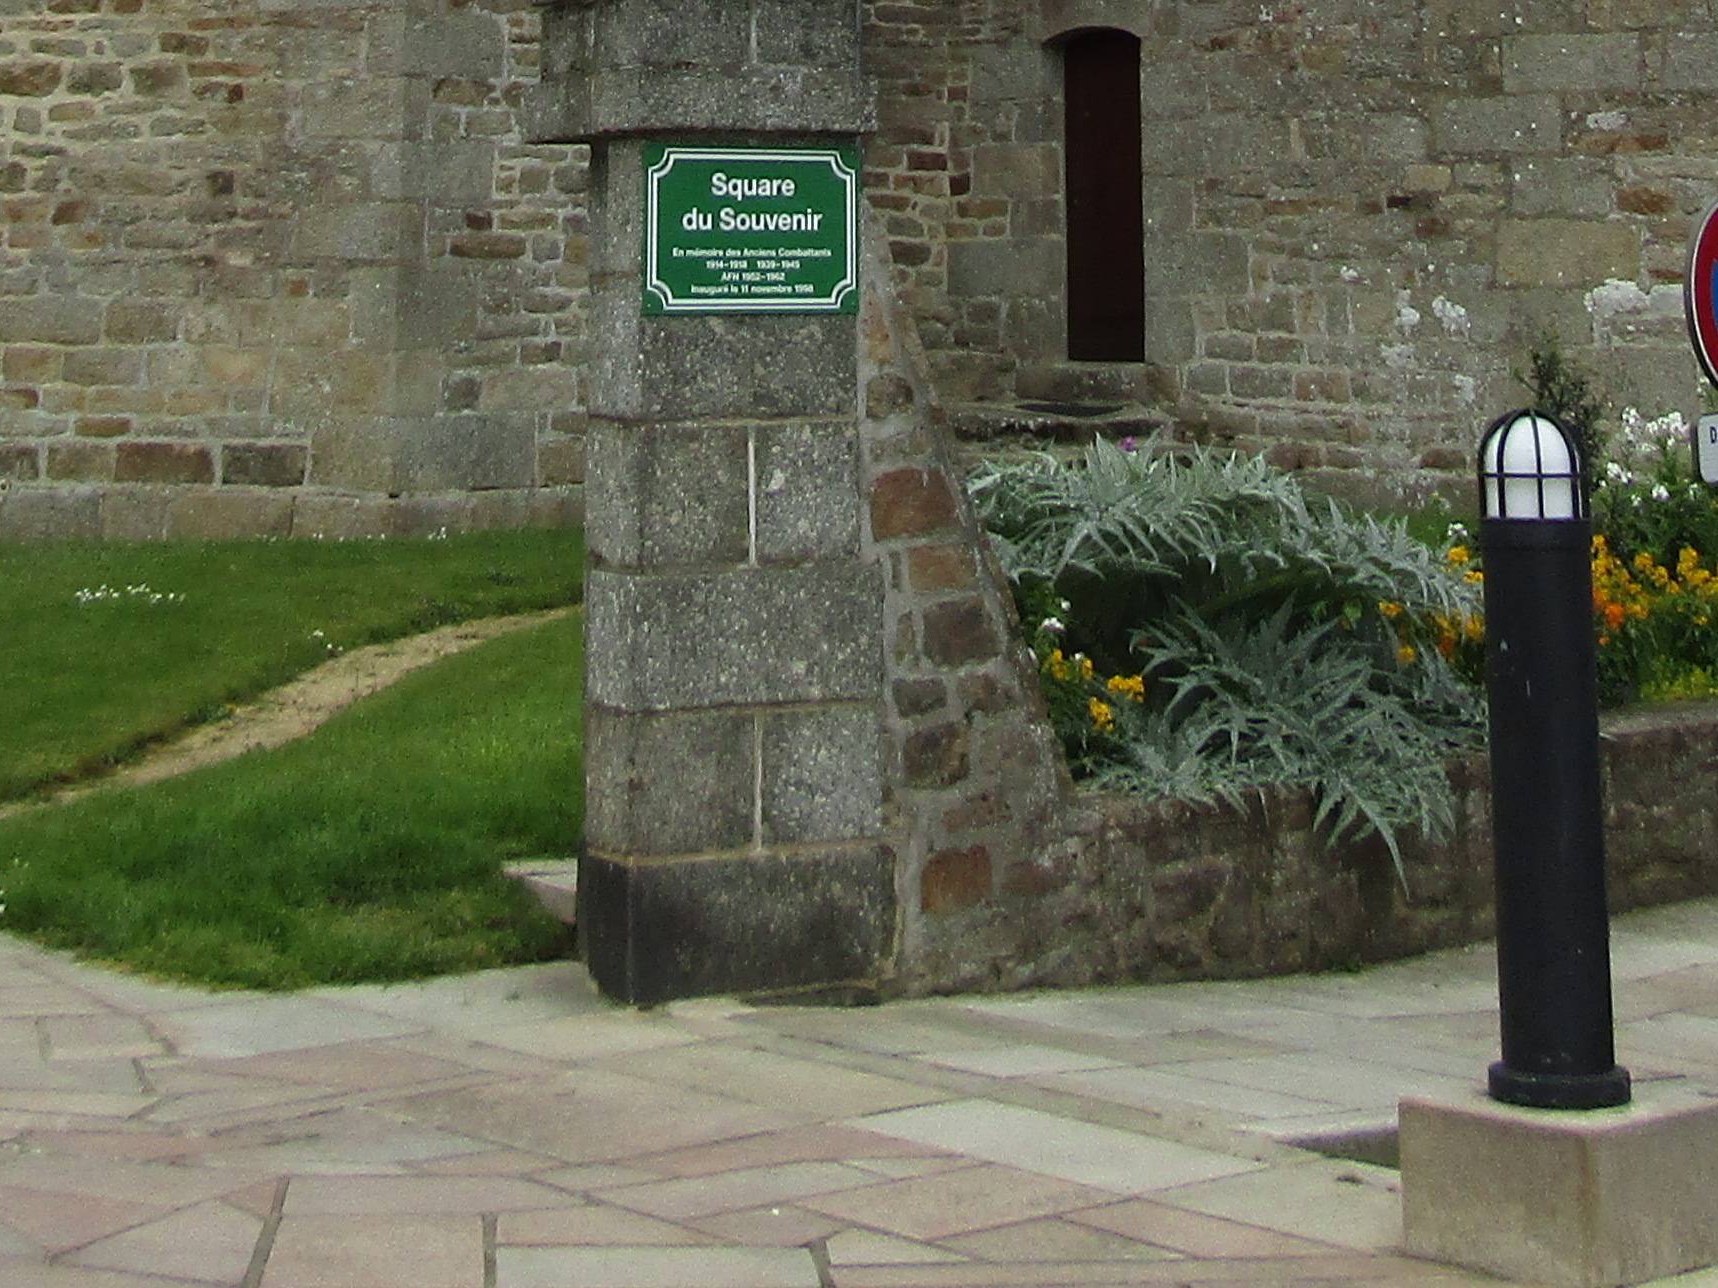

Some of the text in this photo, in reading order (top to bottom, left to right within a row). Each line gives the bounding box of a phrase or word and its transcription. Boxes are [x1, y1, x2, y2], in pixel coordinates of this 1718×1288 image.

[711, 172, 795, 201] Square
[682, 206, 823, 231] du Souvenir
[672, 247, 832, 257] En mémoire des Anciens Combattants
